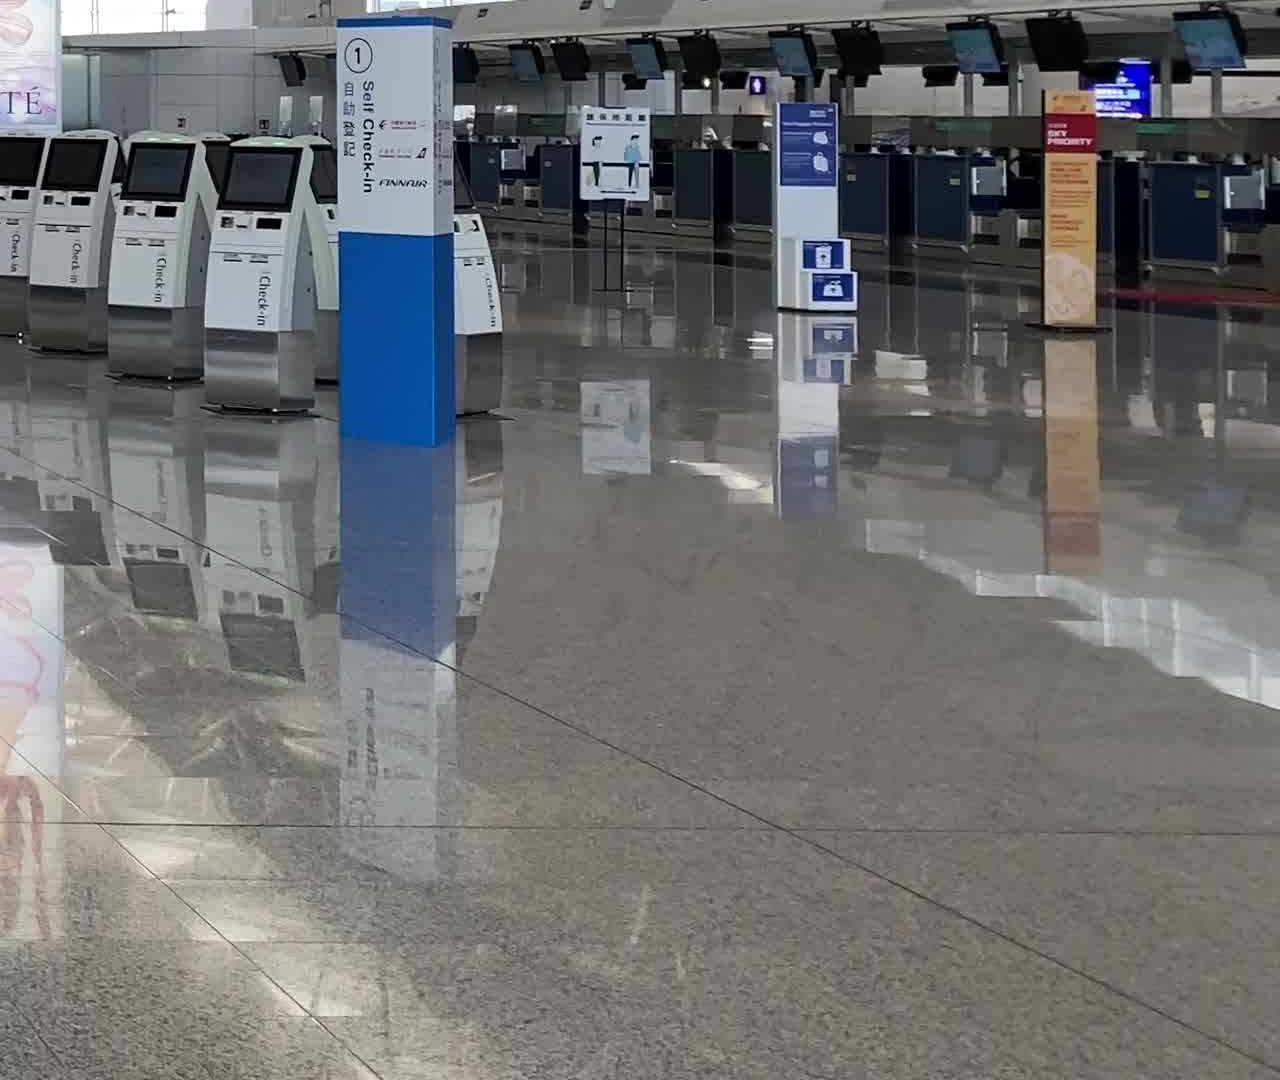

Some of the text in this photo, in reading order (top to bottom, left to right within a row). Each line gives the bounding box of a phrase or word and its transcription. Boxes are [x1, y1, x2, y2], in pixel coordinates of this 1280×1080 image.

[343, 81, 356, 157] 自助登記
[363, 80, 375, 193] Self Check-in
[379, 179, 428, 188] FINNAIR
